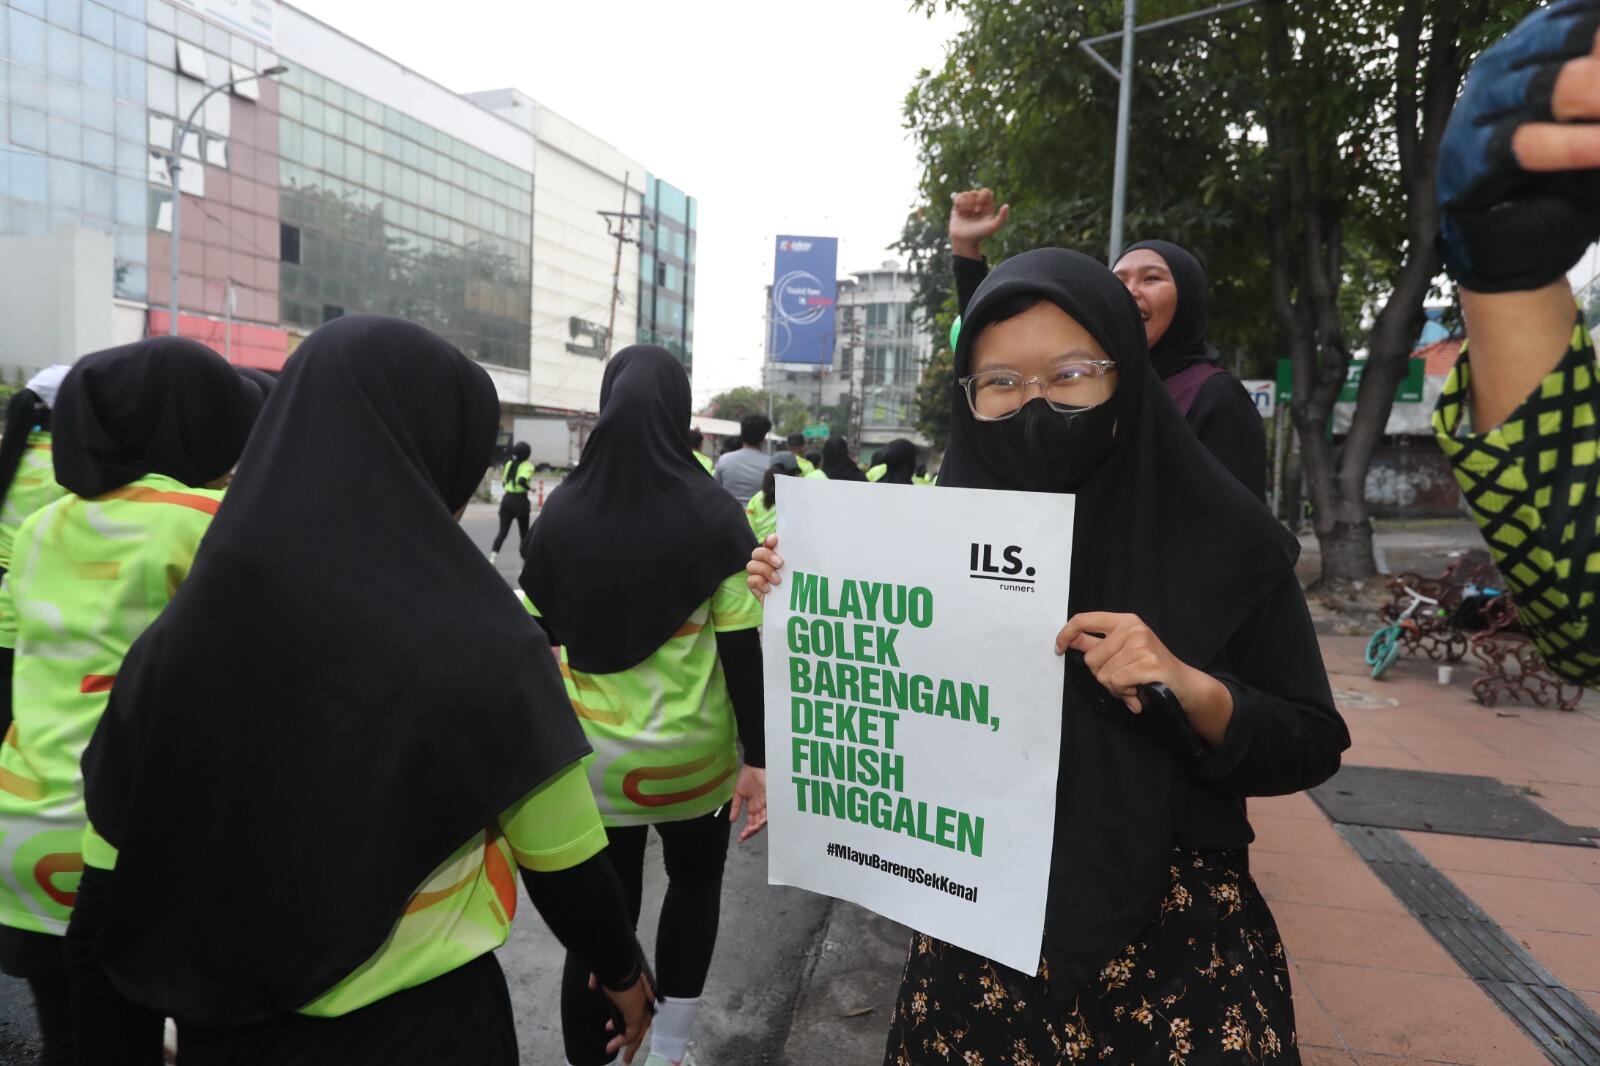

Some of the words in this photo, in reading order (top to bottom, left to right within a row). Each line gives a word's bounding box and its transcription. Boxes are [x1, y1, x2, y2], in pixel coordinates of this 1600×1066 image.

[970, 543, 1036, 577] ILS.
[790, 571, 933, 629] MLAYUO
[999, 584, 1036, 593] runners
[788, 616, 900, 667] GOLEK
[790, 658, 1000, 732] BARENGAN,
[792, 697, 900, 750] DEKET
[793, 738, 904, 792] FINISH
[792, 777, 985, 857] TINGGALEN
[827, 842, 978, 904] #MlayuBarengSekKenal
